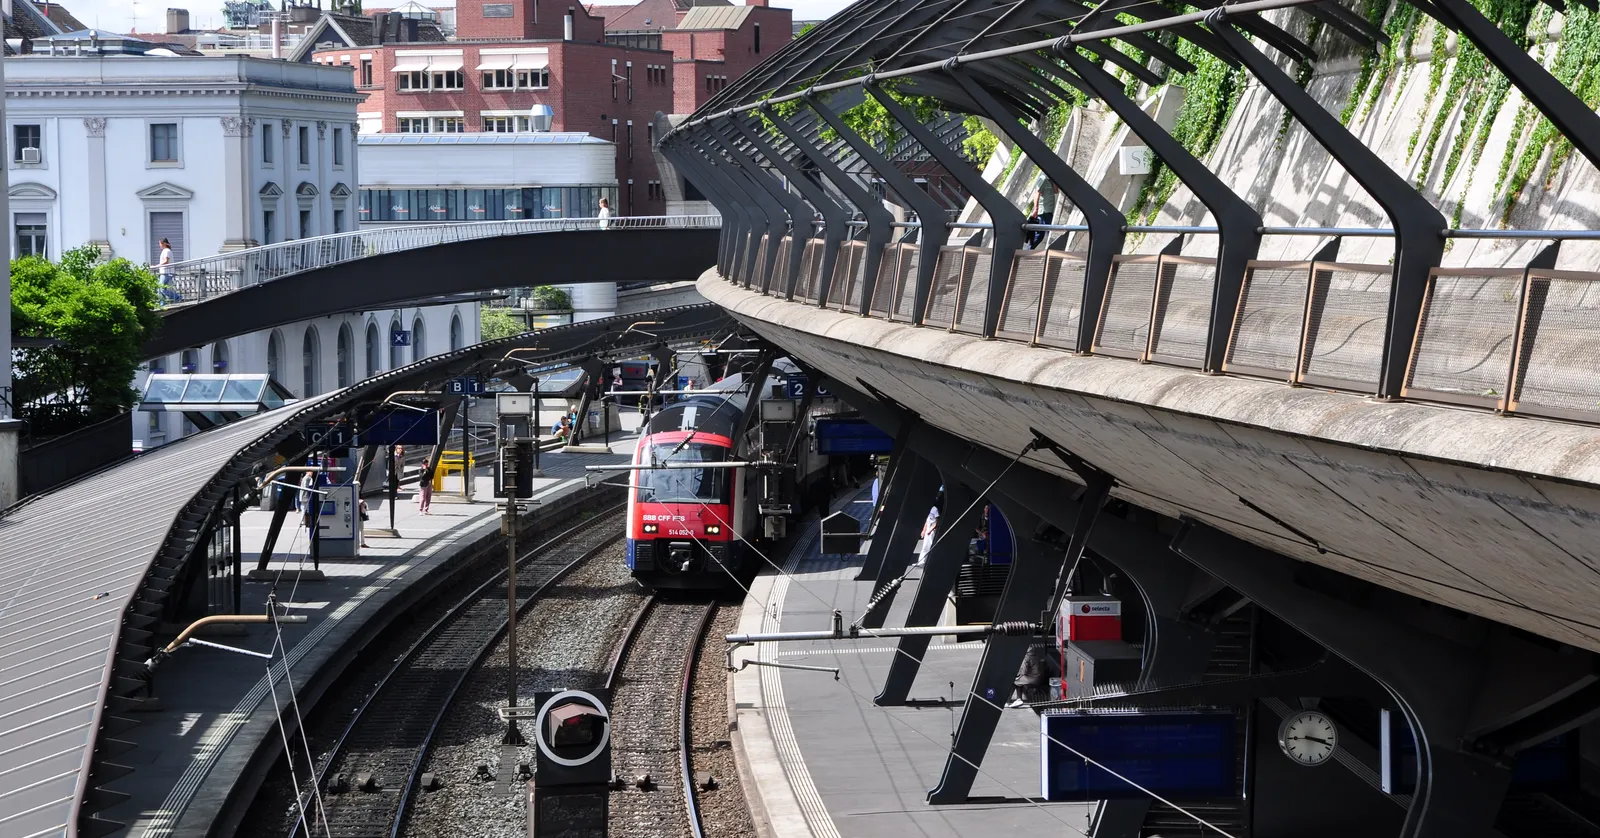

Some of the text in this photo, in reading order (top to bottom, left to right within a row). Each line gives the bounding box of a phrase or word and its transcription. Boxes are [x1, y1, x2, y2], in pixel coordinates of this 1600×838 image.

[453, 382, 478, 392] B 1
[794, 383, 804, 395] 2
[337, 431, 343, 444] 1
